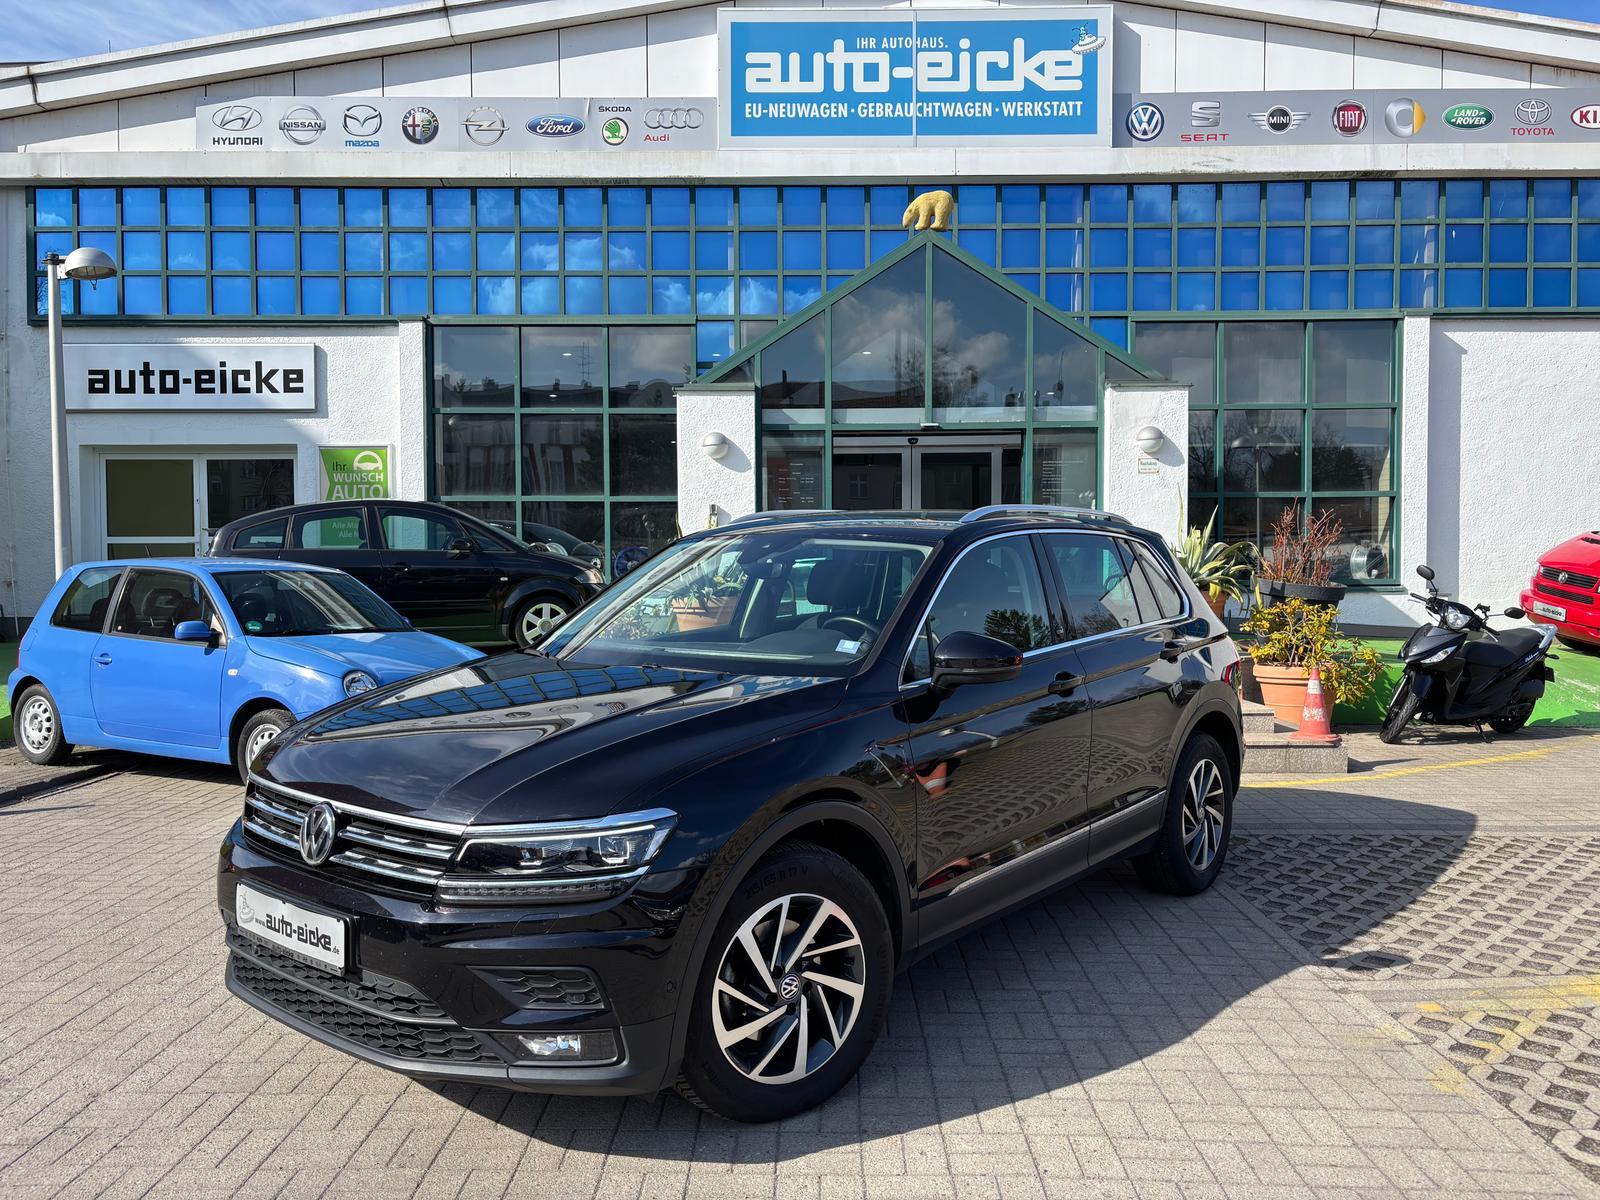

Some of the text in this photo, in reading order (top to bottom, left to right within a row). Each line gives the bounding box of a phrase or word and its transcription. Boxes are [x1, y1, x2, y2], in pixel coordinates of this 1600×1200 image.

[856, 36, 949, 49] IHR AUTOHAUS.
[745, 37, 1083, 93] auto-eicke
[745, 100, 1083, 118] EU-NEUWAGEN GEBRAUCHTWAGEN WERKSTATT
[1453, 109, 1480, 118] LAND
[1269, 116, 1290, 124] MINI
[1339, 110, 1360, 128] FIAT
[1455, 117, 1487, 125] ROVER
[1579, 110, 1600, 124] KI
[283, 121, 322, 129] NISSAN
[536, 117, 574, 134] Ford
[1511, 127, 1555, 136] TOYOTA
[212, 136, 263, 146] HYUNDAI
[643, 133, 670, 142] Audi
[1180, 133, 1230, 142] SEAT
[345, 140, 380, 148] mazda
[87, 360, 305, 395] auto-eicke
[332, 461, 347, 472] Ihr
[333, 472, 384, 483] WUNSCH
[332, 484, 384, 501] AUTO
